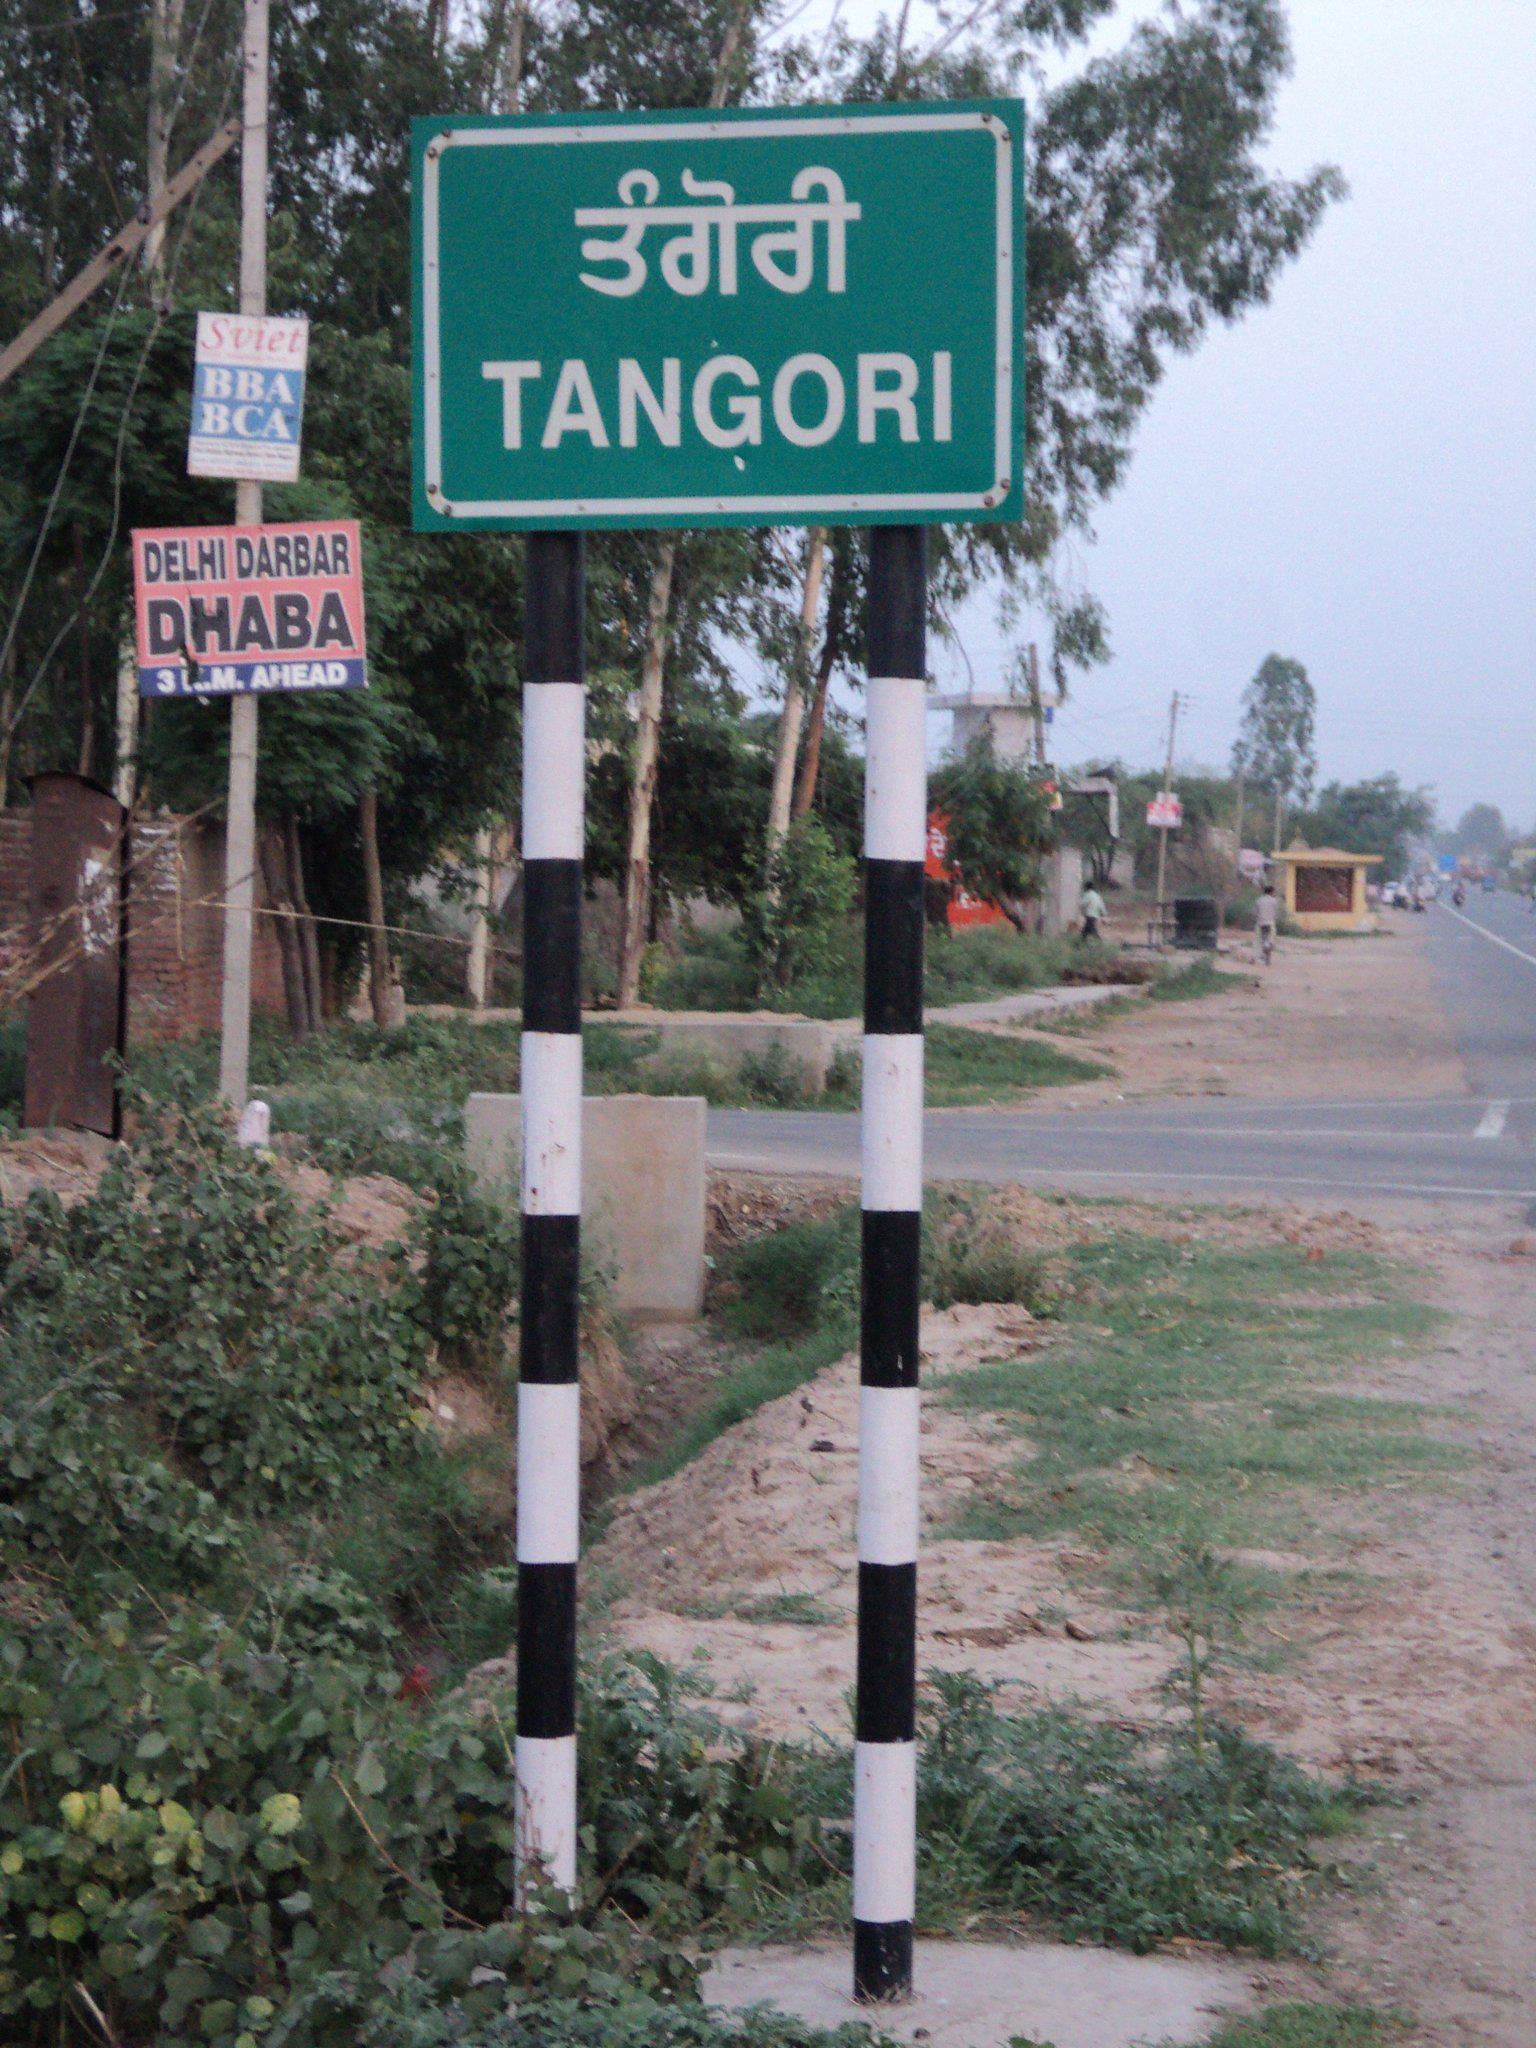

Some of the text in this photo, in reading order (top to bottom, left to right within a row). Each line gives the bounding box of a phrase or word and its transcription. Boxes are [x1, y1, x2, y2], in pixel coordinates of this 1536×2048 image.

[575, 165, 862, 297] ਤੰਗੋਰੀ
[203, 366, 295, 405] BBA
[481, 350, 952, 449] TANGORI
[199, 402, 291, 440] BCA
[144, 533, 349, 583] DELHI DARBAR
[148, 592, 354, 656] DHABA
[156, 668, 176, 693] 3
[250, 662, 349, 690] AHEAD
